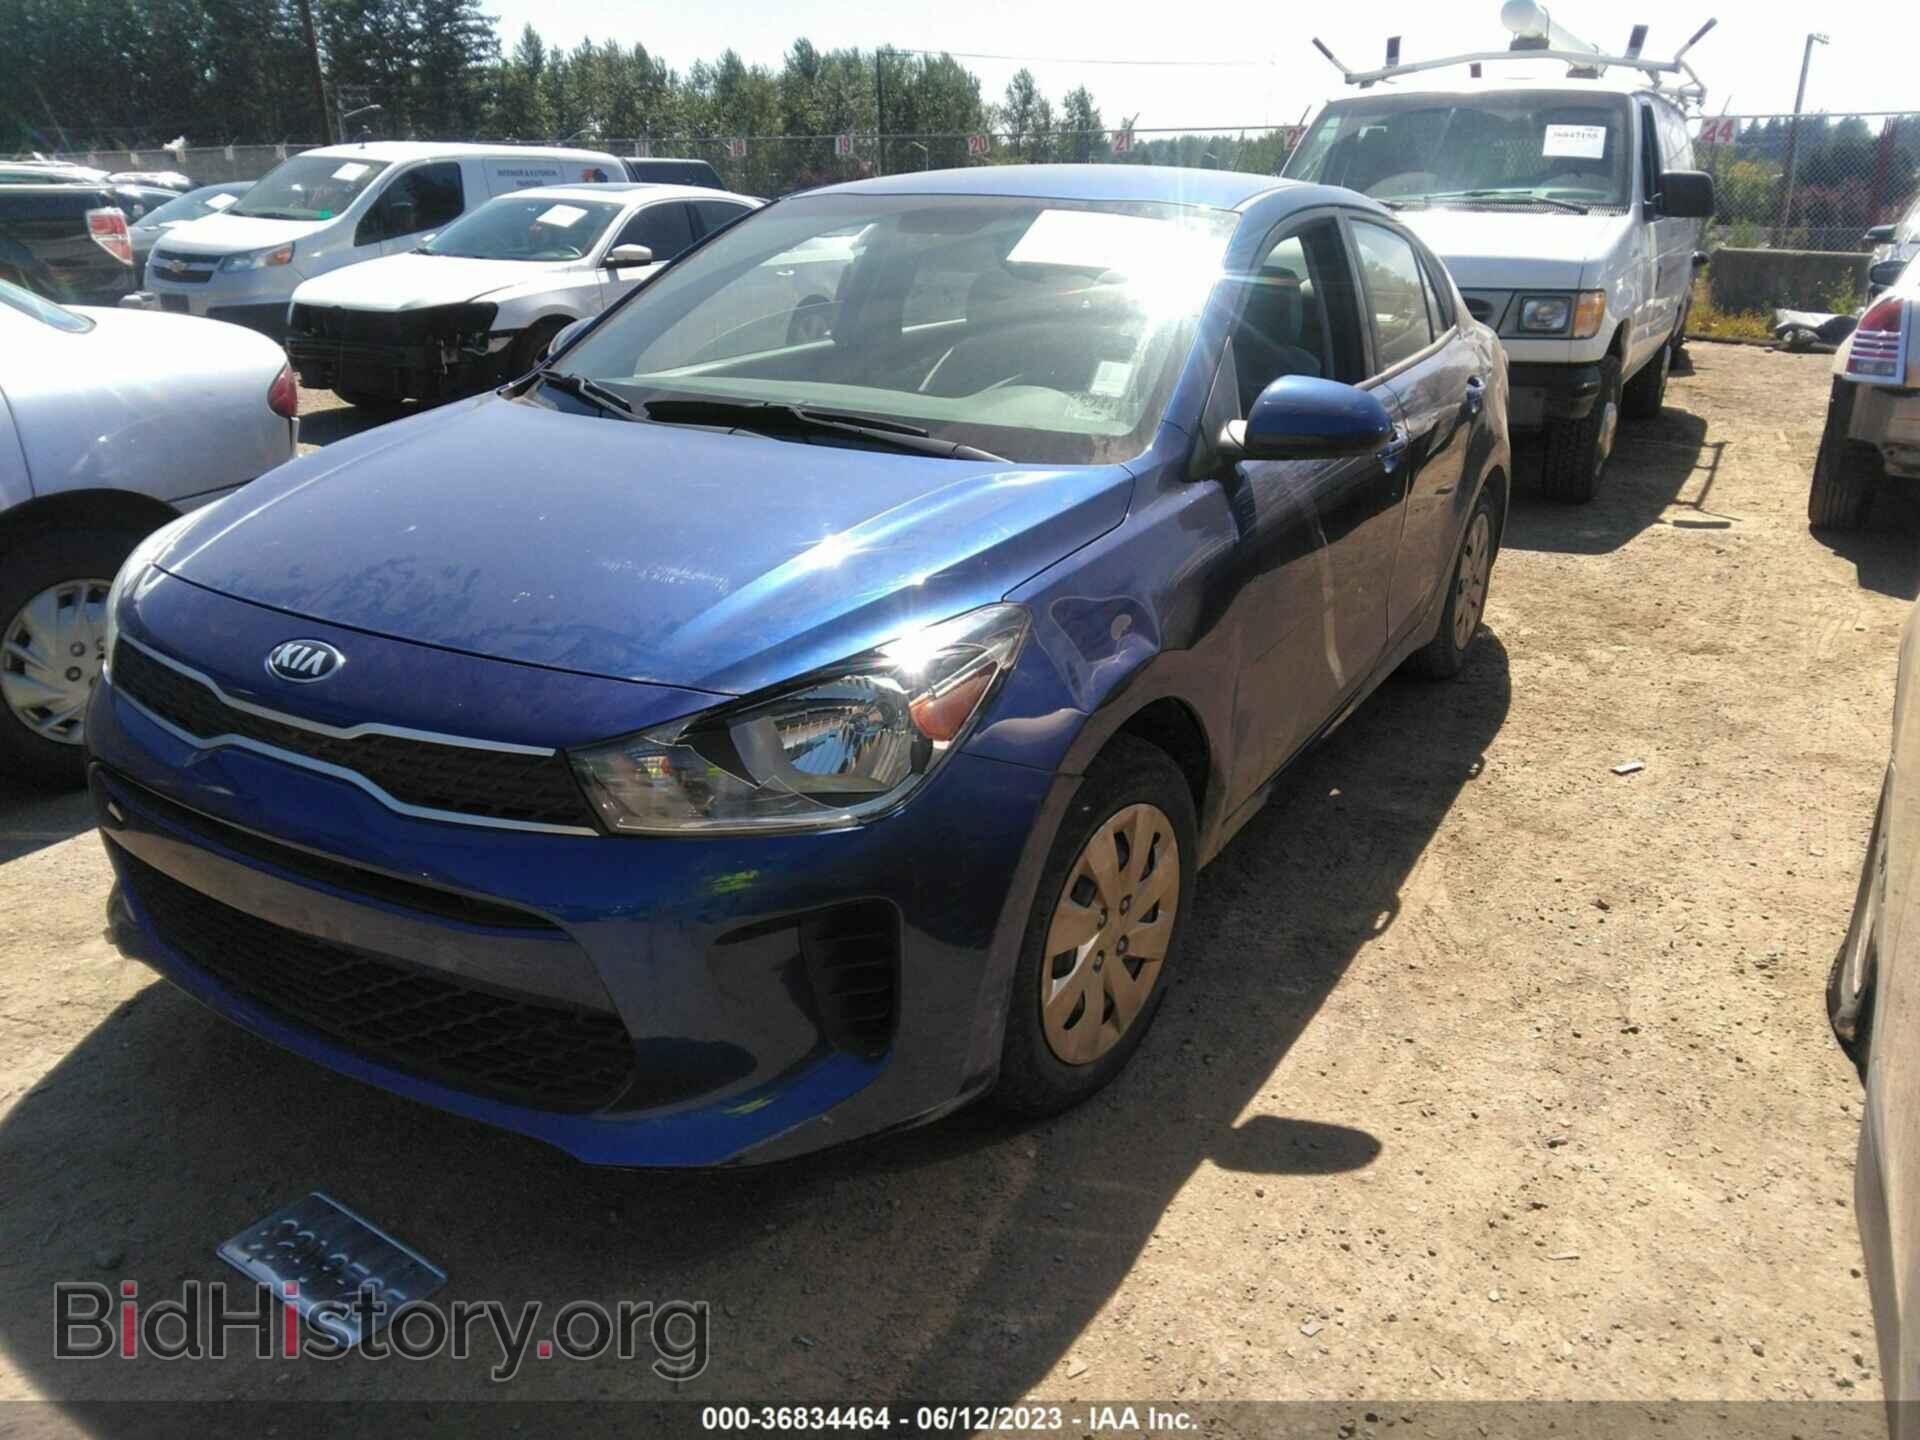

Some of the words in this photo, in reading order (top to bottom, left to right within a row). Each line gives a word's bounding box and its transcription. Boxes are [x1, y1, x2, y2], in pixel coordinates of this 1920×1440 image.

[1114, 133, 1130, 151] 21
[1702, 118, 1734, 144] 24
[968, 135, 989, 153] 20
[274, 643, 328, 676] KIA
